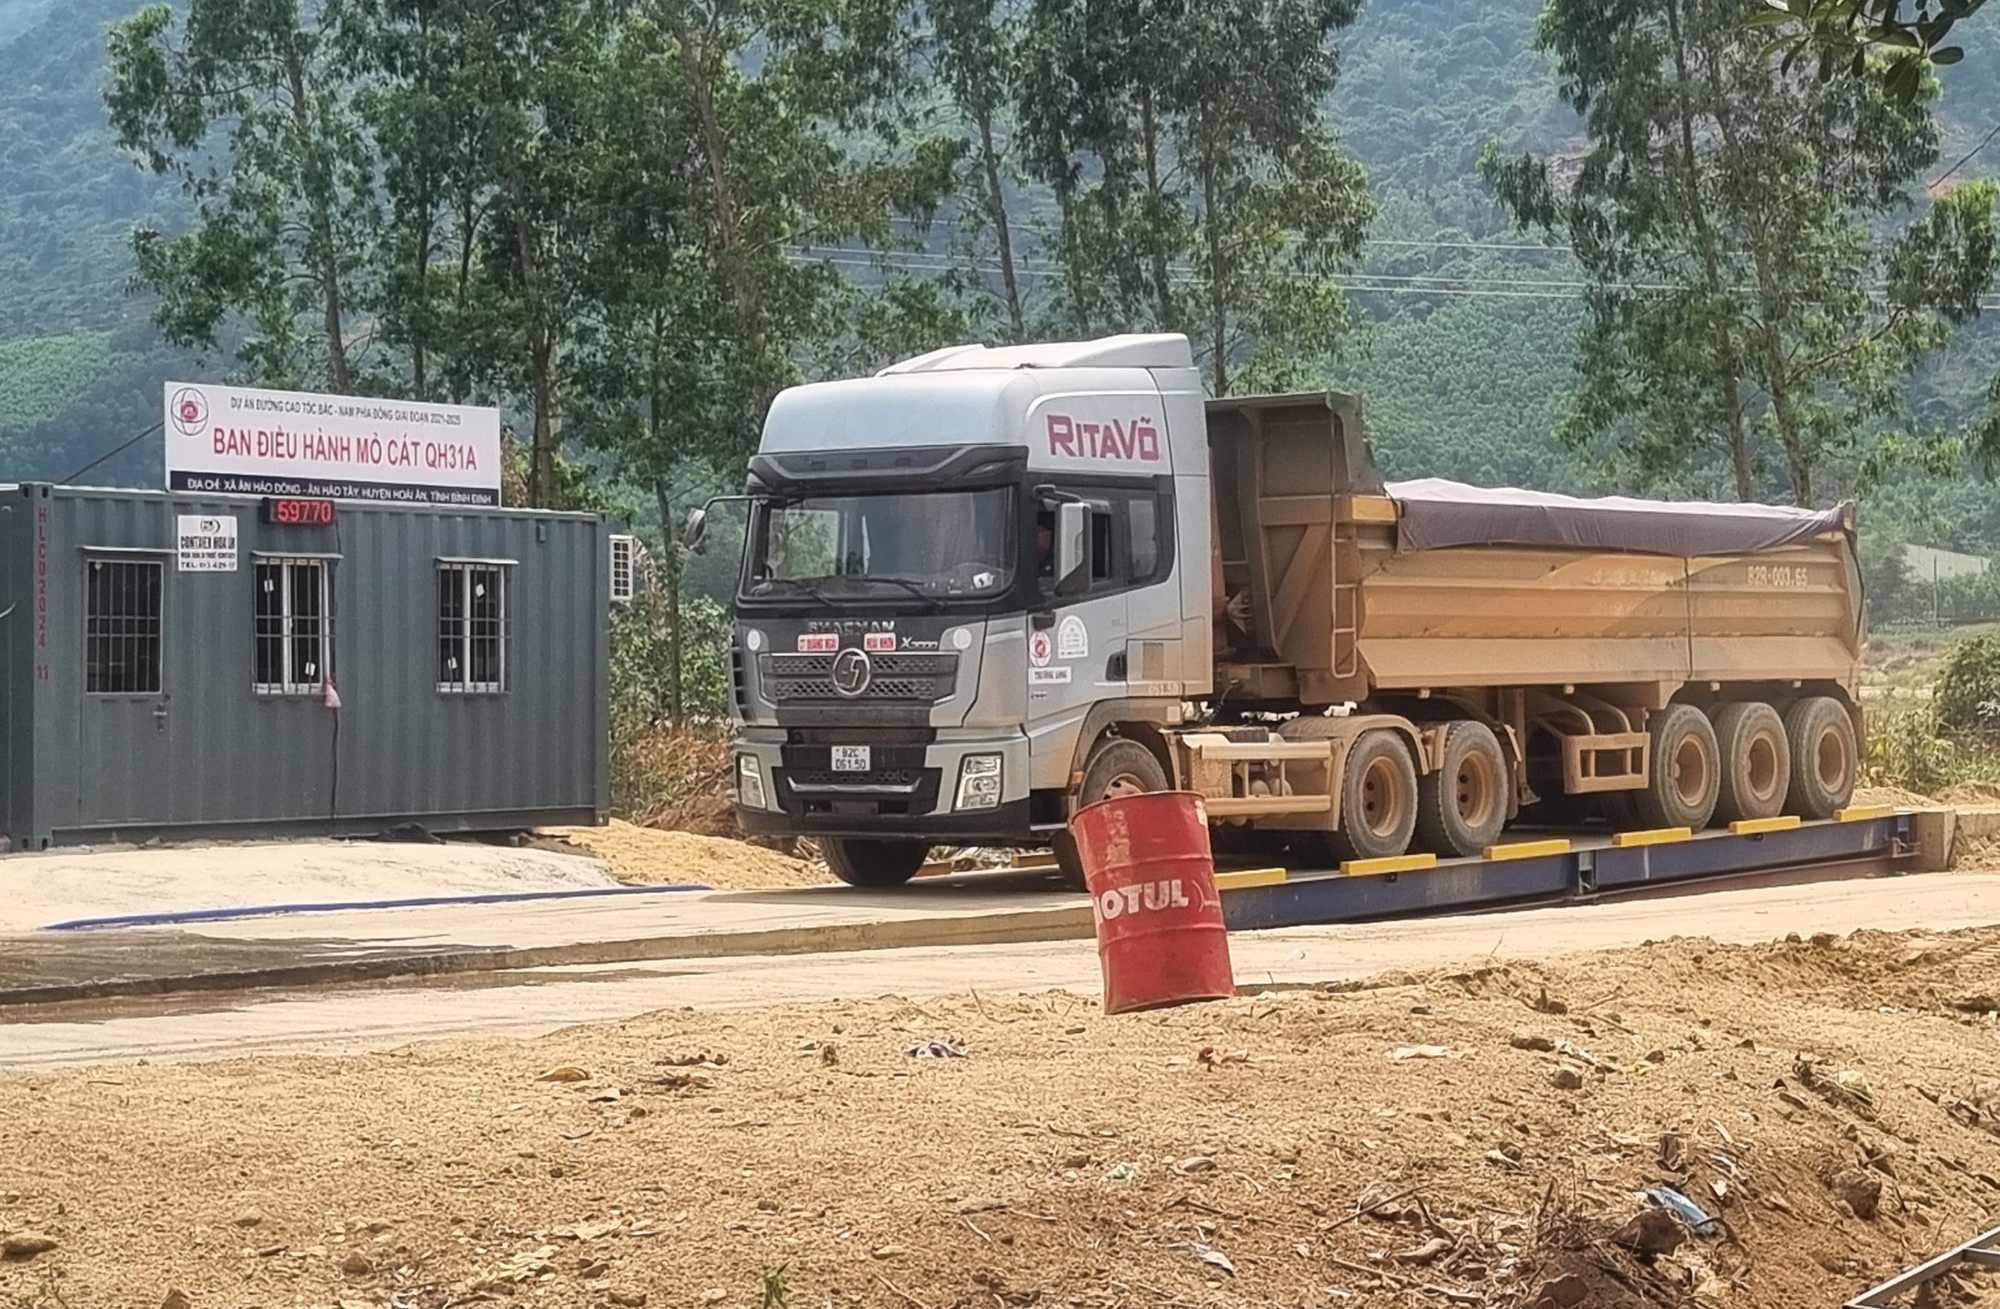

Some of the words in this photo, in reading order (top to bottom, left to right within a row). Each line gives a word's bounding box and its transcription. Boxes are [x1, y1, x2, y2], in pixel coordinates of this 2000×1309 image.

[285, 401, 301, 413] CAO
[213, 427, 251, 456] BAN
[303, 427, 350, 463] HÀNH
[387, 433, 421, 467] CÁT
[425, 441, 477, 471] QH31A
[277, 501, 332, 522] 59770
